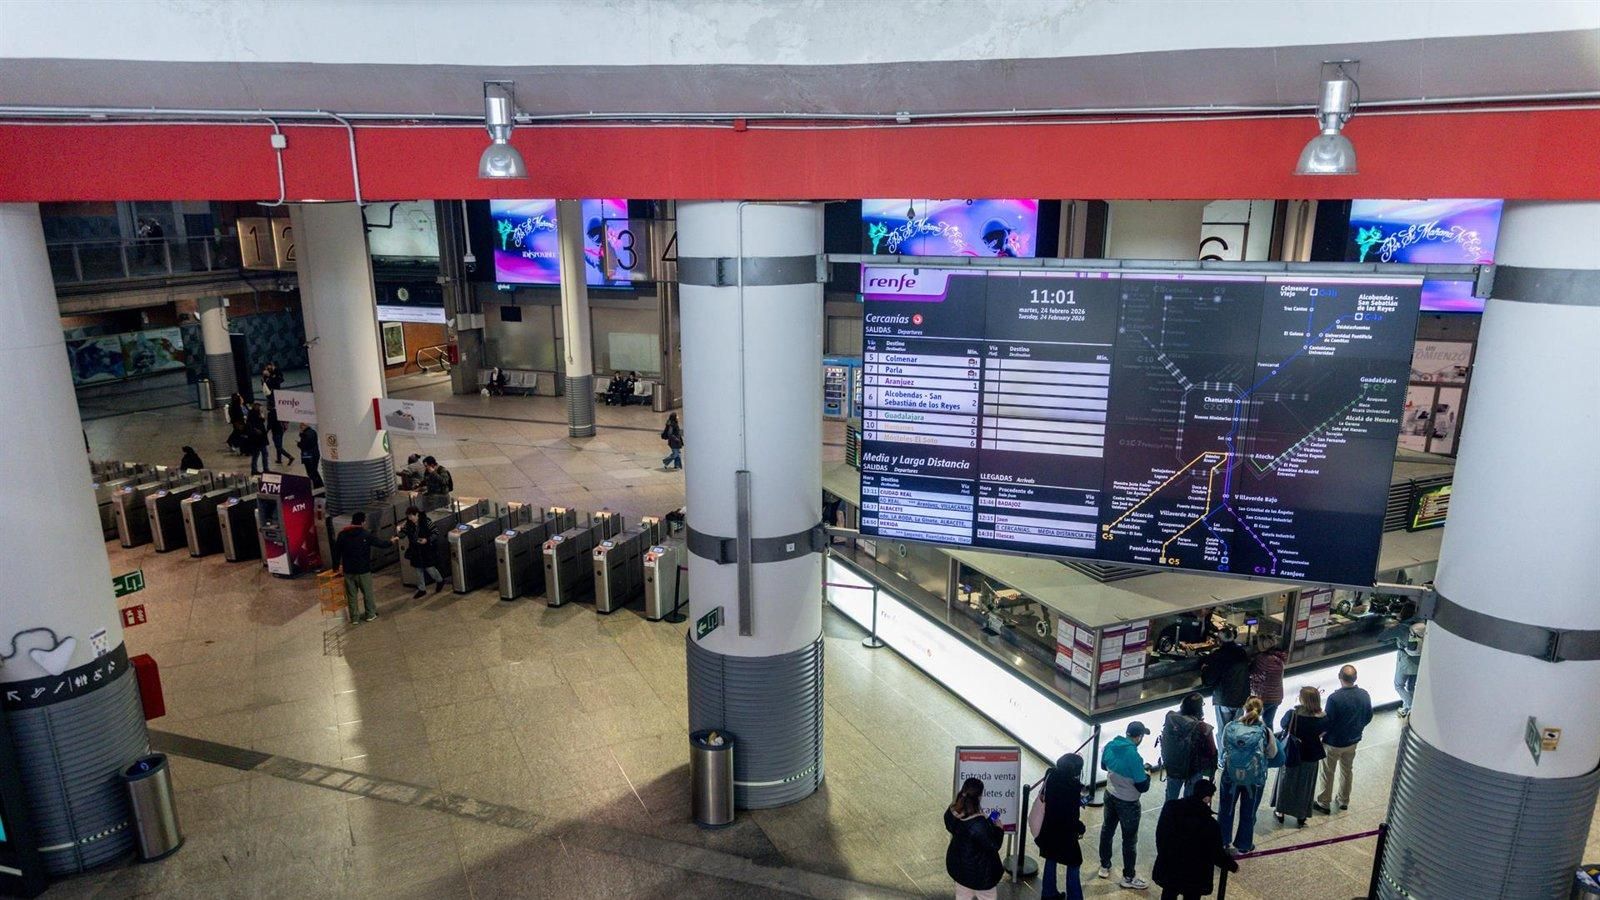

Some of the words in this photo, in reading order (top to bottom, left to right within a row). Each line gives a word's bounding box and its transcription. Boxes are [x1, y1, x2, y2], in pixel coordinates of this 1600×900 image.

[249, 225, 261, 262] 1
[617, 230, 637, 270] 3
[870, 274, 916, 292] renfe
[1030, 289, 1076, 304] 11:01
[866, 313, 909, 324] Cercanías
[886, 355, 917, 363] Colmenar
[885, 378, 914, 386] Aranjuez
[885, 390, 922, 399] Alcobendas
[278, 397, 300, 408] renfe
[885, 399, 917, 407] Sebastián
[919, 399, 927, 408] de
[929, 400, 939, 408] los
[941, 401, 960, 410] Reyes
[885, 412, 924, 422] Guadalajara
[863, 453, 889, 463] Media
[892, 456, 897, 465] y
[900, 455, 925, 467] Larga
[927, 457, 970, 469] Distancia
[980, 473, 1013, 481] LLEGADAS
[261, 482, 281, 494] ATM
[292, 502, 306, 513] ATM
[1160, 510, 1186, 518] Villaverde
[1129, 545, 1160, 553] Fuenlabrada
[960, 772, 992, 780] Entrada
[1005, 789, 1015, 798] de
